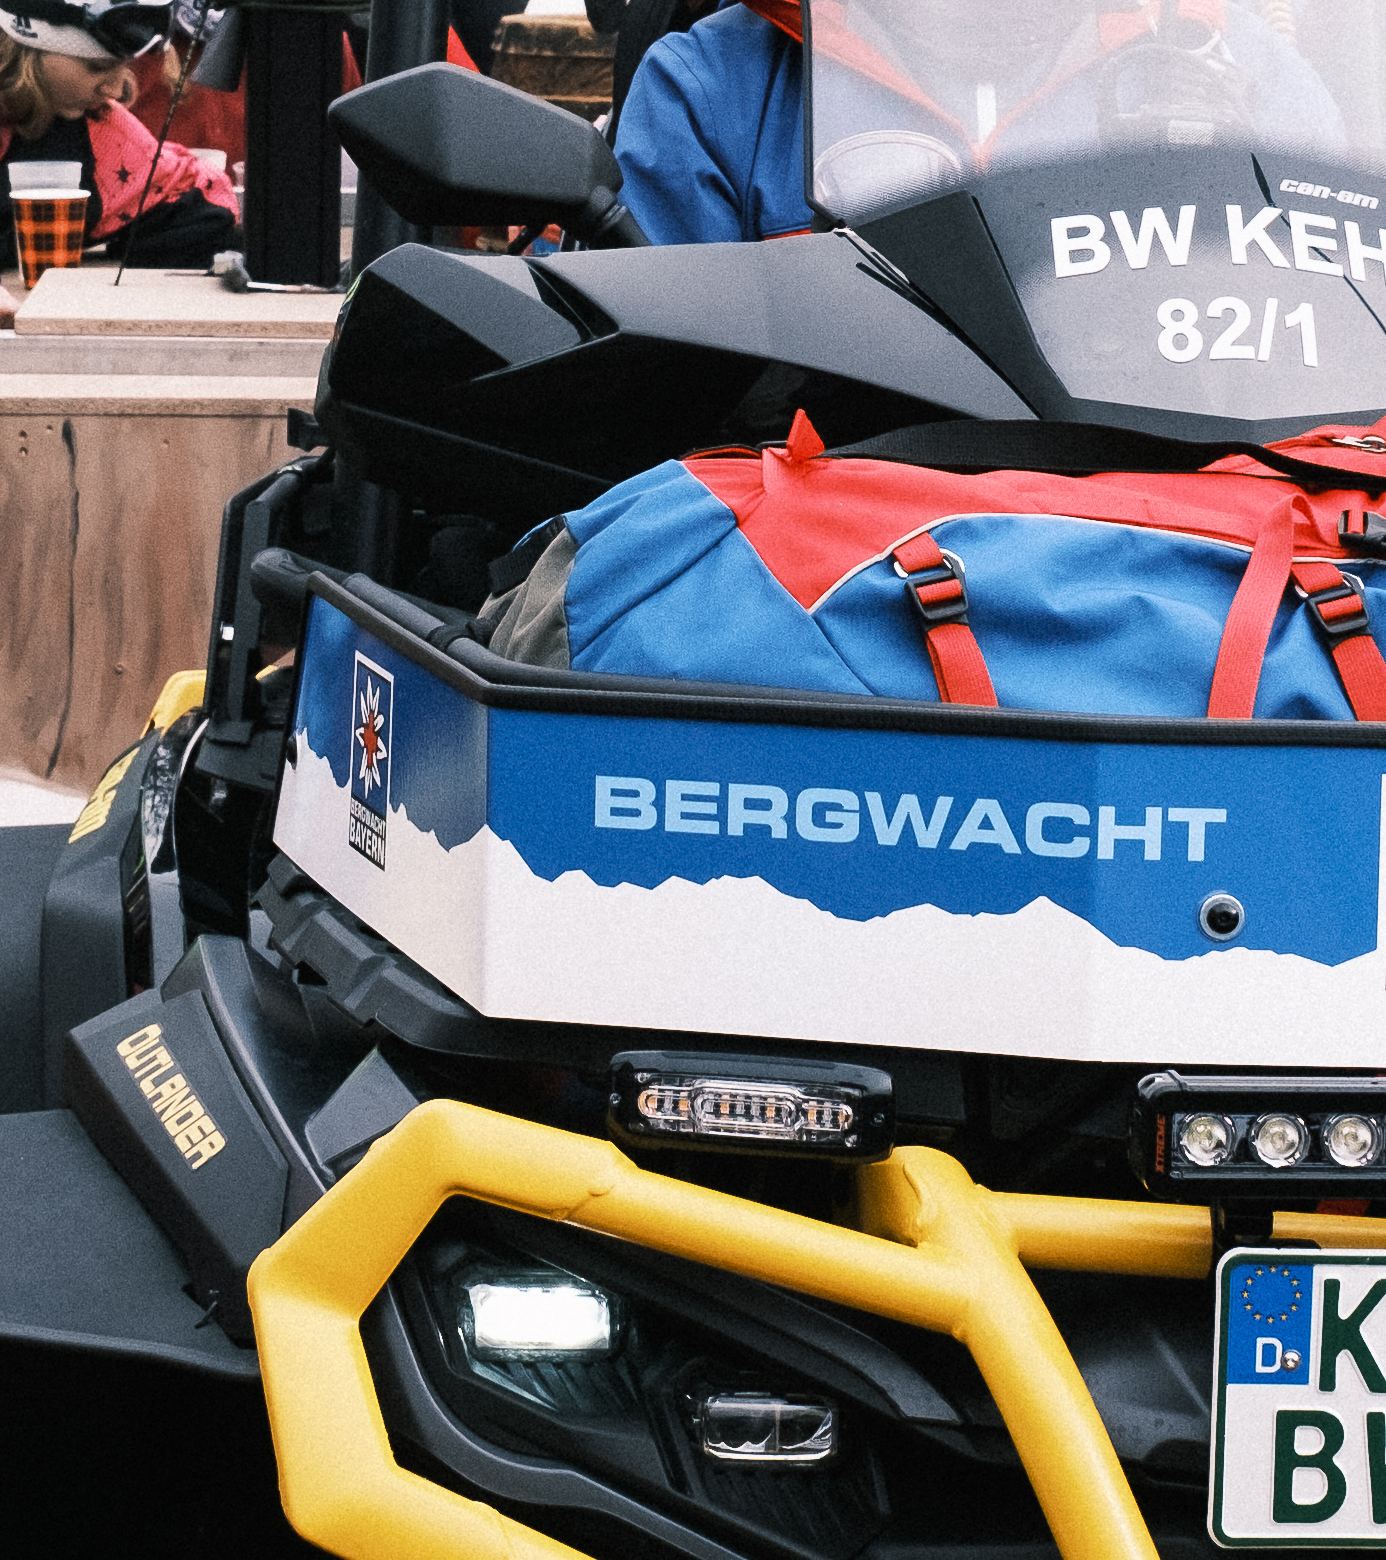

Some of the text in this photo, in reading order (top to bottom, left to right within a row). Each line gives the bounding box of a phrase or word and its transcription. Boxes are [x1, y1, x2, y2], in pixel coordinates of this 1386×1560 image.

[1279, 178, 1380, 210] can-am
[1050, 203, 1198, 279] BW
[1156, 295, 1319, 368] 82/1
[349, 814, 385, 866] BAYERN
[594, 774, 1228, 862] BERGWACHT
[116, 1023, 226, 1170] OUTLANDER
[1255, 1336, 1286, 1374] D
